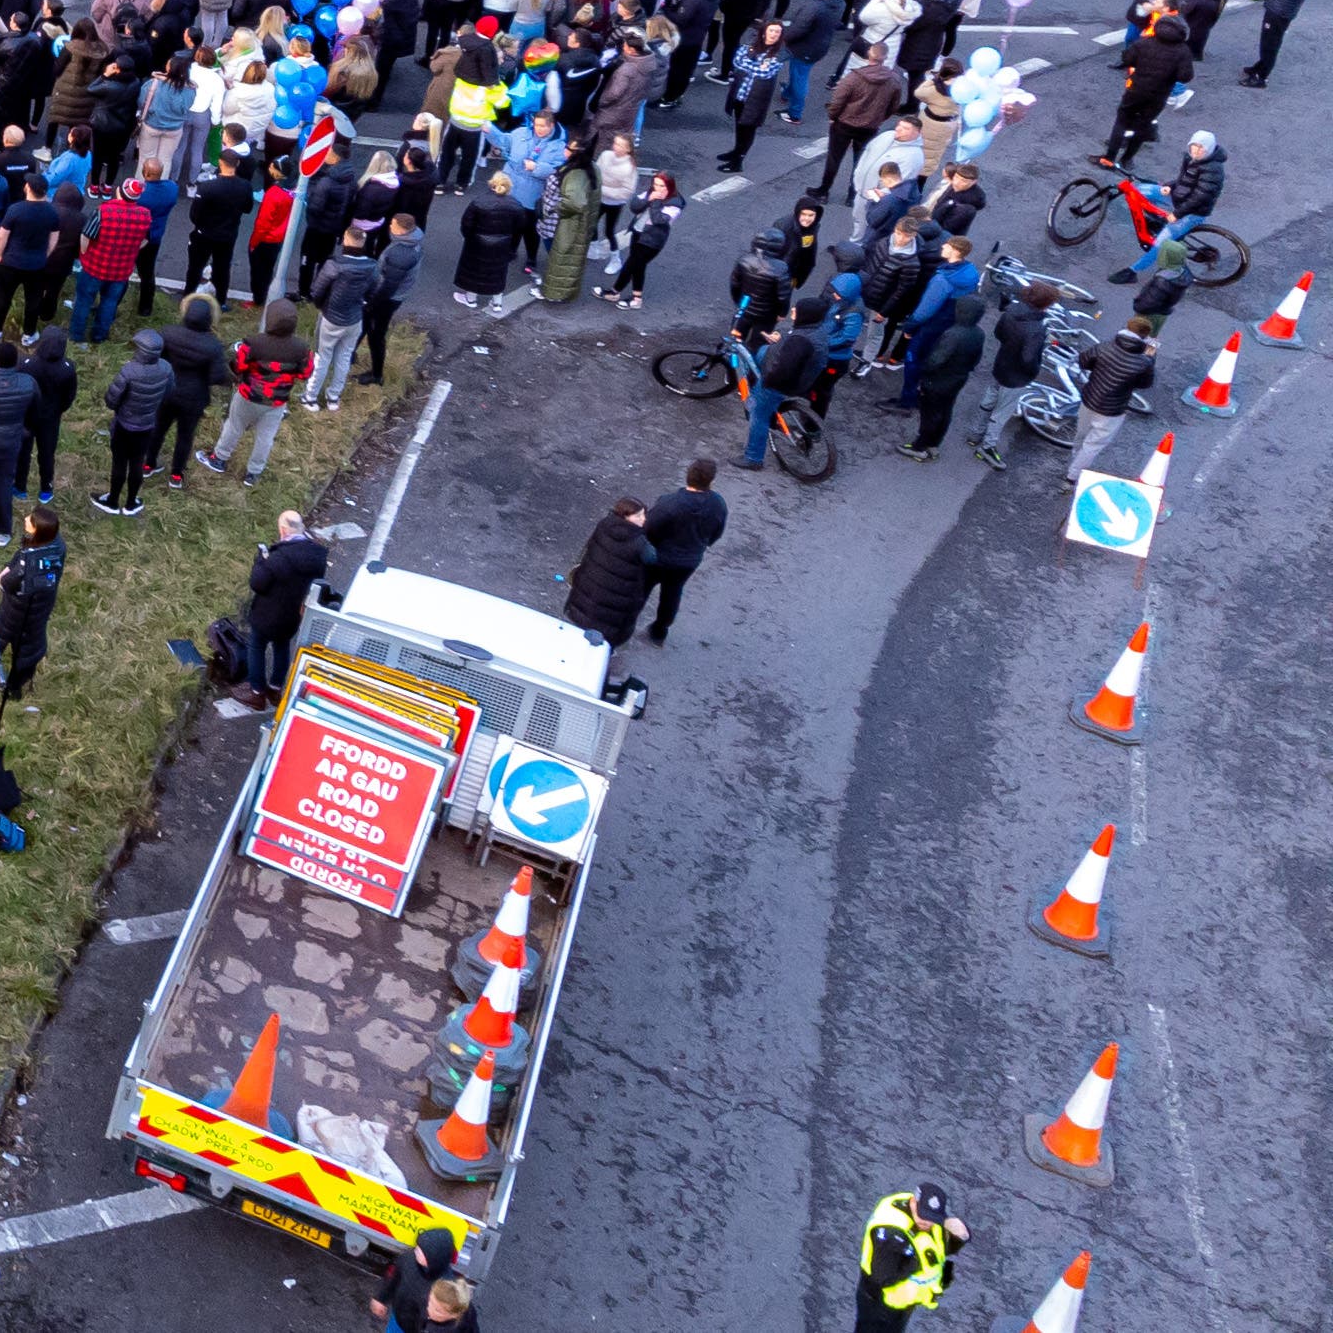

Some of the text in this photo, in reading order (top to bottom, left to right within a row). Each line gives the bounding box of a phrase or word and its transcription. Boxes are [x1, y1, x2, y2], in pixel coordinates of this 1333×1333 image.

[320, 734, 407, 781] FFORDD
[315, 758, 399, 802] AR GAU
[317, 781, 379, 817] ROAD
[298, 798, 385, 844] CLOSED
[290, 855, 363, 896] FFORDD
[154, 1116, 274, 1172] CHADW PRIFFYRDD
[185, 1118, 249, 1151] CYNNAL A
[338, 1194, 427, 1236] MAINTENANC
[360, 1193, 421, 1223] HIGHWAY
